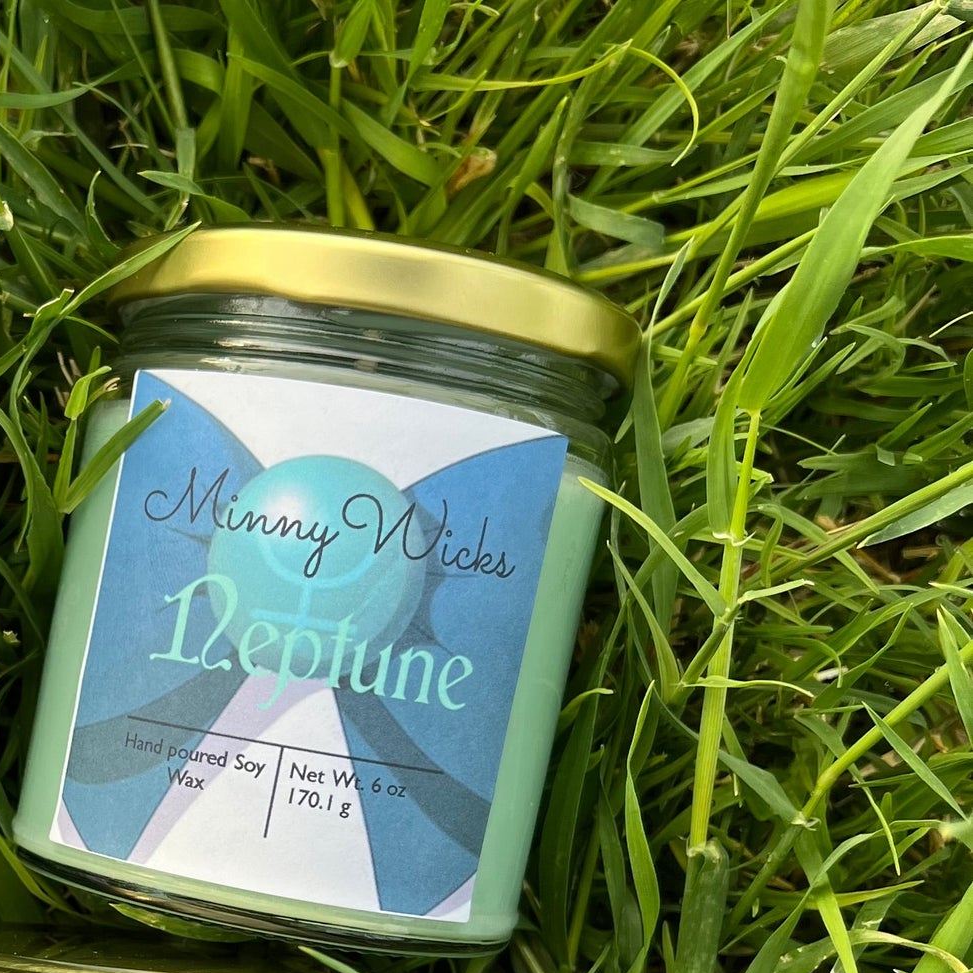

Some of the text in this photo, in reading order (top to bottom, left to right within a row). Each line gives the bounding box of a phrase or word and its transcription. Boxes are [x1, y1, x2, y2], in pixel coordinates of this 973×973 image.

[144, 466, 516, 579] Minny Wicks
[149, 574, 474, 711] Neptune
[124, 732, 266, 778] Hand poured Soy
[167, 767, 206, 790] Wax
[289, 762, 407, 798] Net Wt. 6 oz
[287, 788, 352, 819] 170.1 g
